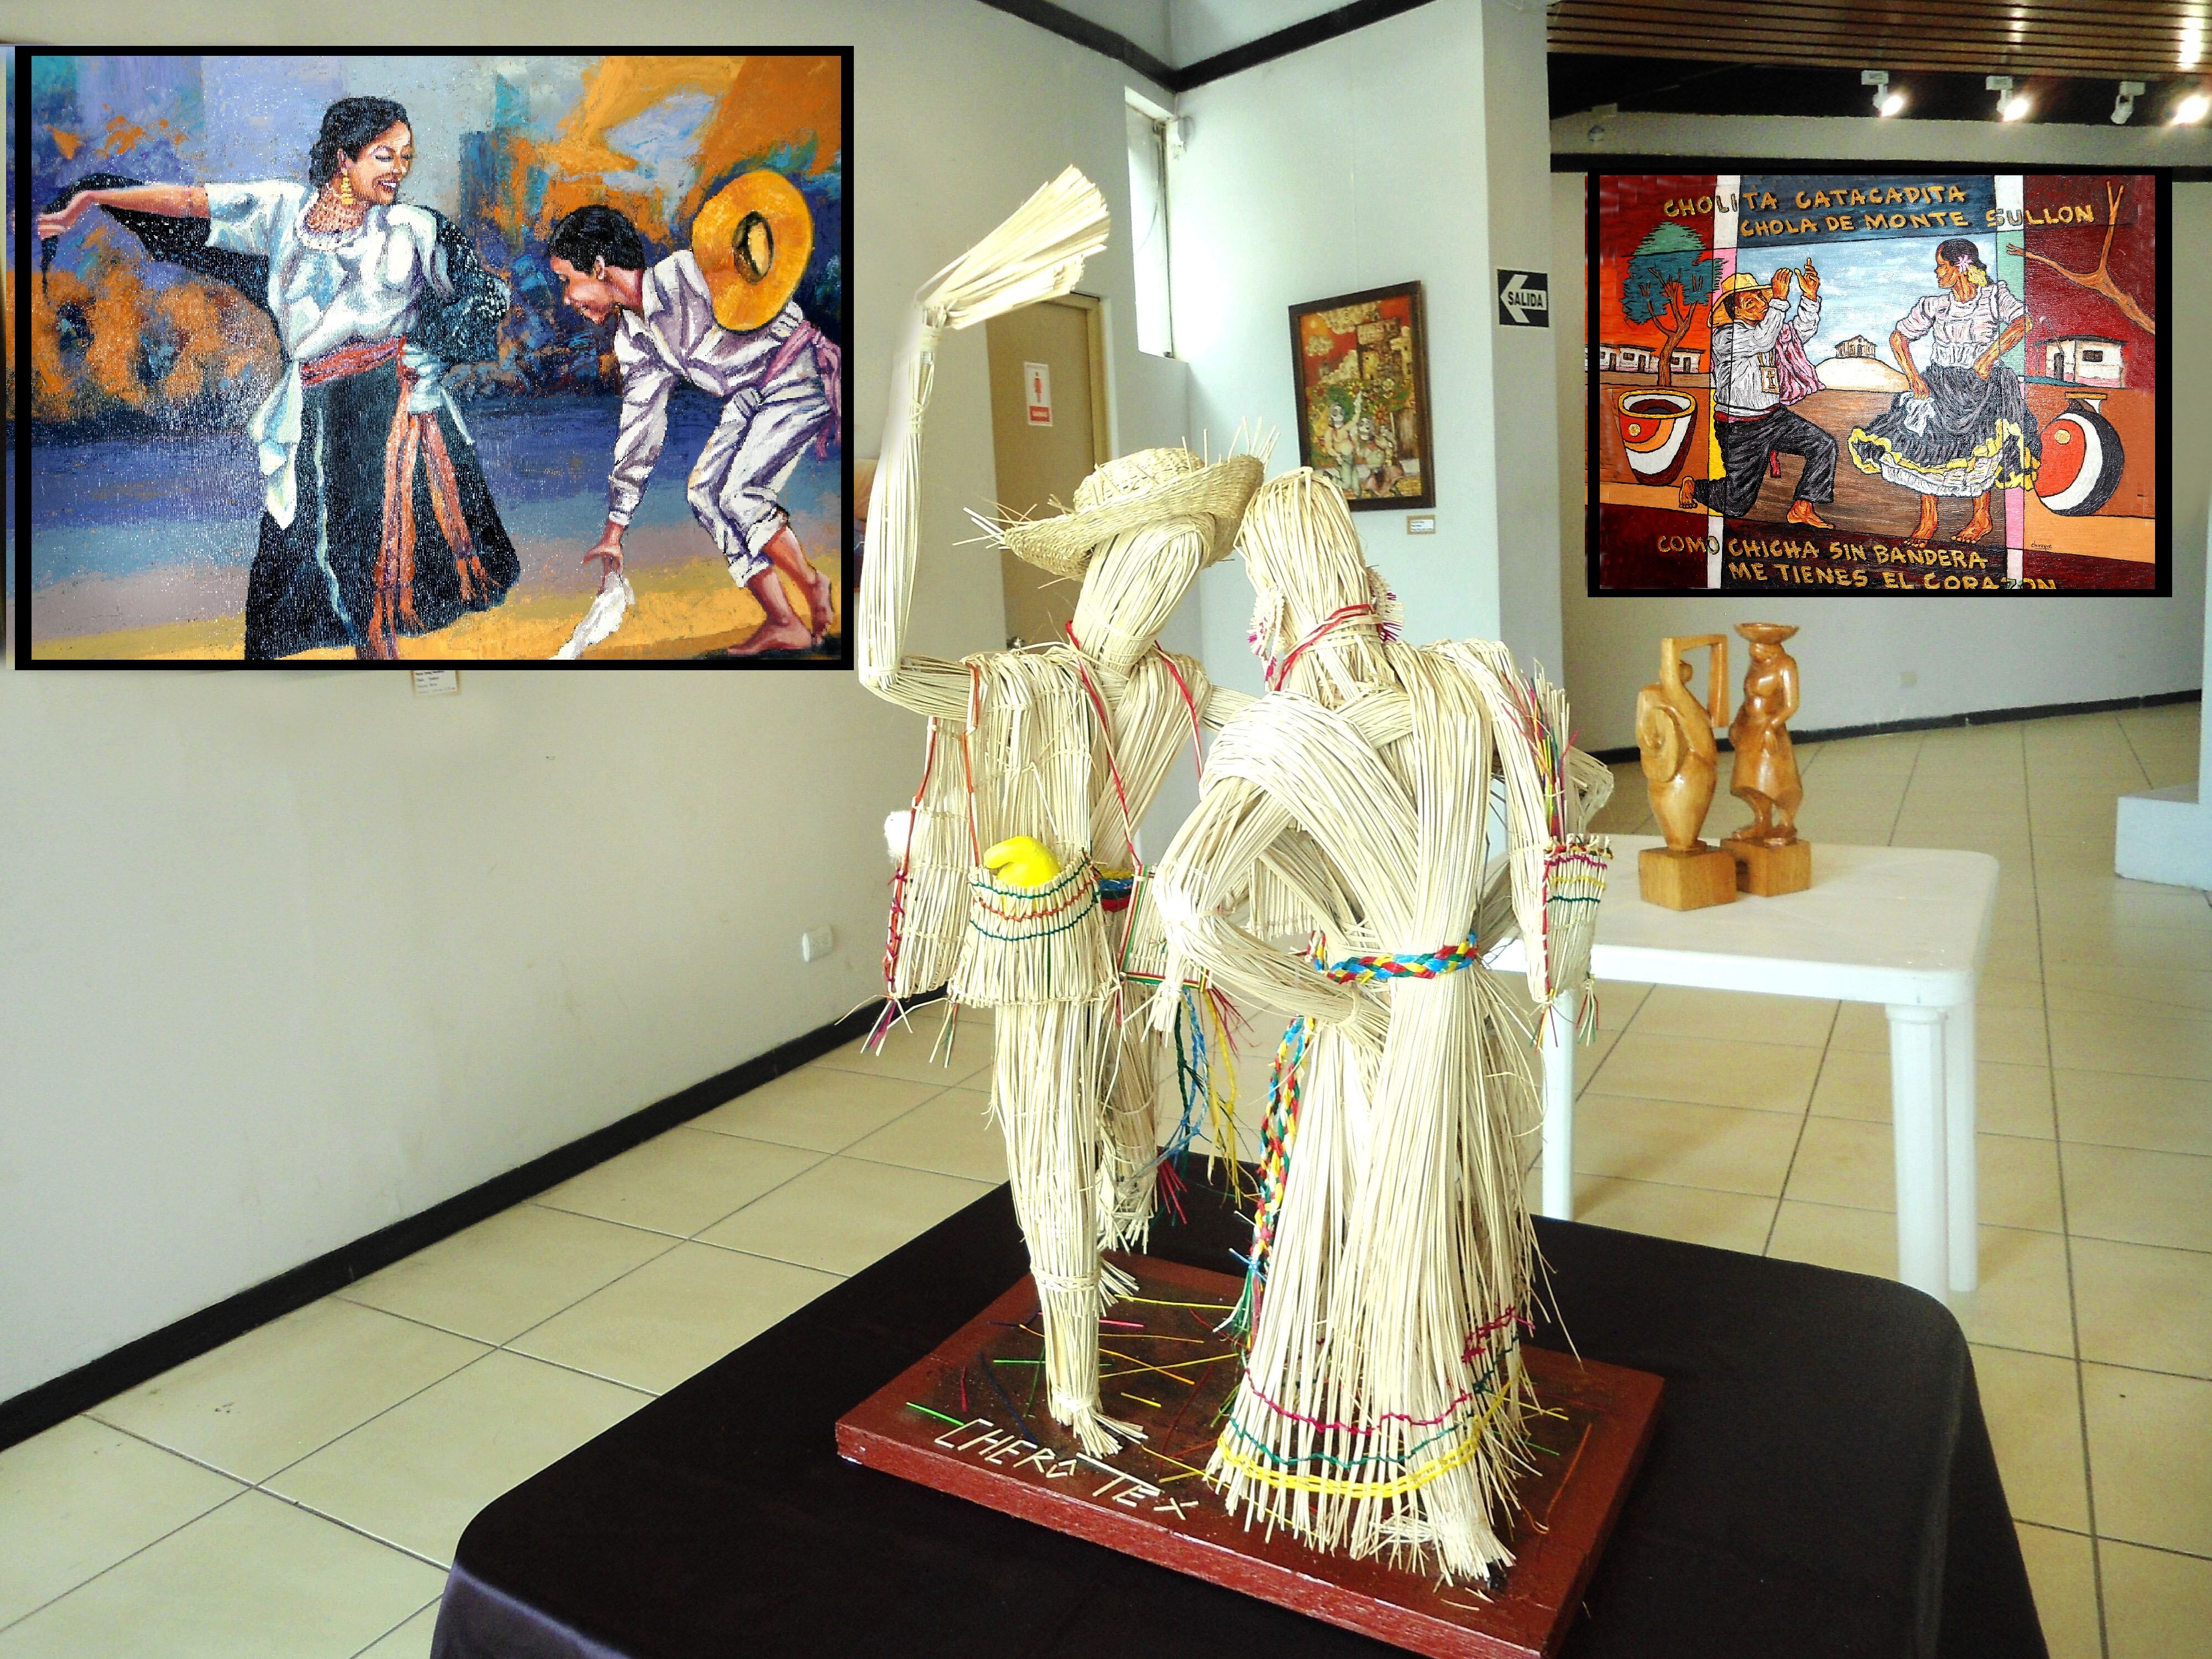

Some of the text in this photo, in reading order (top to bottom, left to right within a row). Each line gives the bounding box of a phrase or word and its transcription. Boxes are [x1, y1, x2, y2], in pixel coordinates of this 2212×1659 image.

[1663, 186, 1968, 217] CHOLITA CATACADITA
[1740, 205, 2094, 237] CHOLA DE MONTE SULLON
[1507, 290, 1543, 308] SALIDA
[1658, 535, 1989, 570] COMO CHICHA SIN BANDERA
[1728, 562, 1768, 581] ME
[1772, 563, 1868, 587] TIENES
[1882, 571, 1914, 589] EL
[935, 1417, 1077, 1479] CHERO
